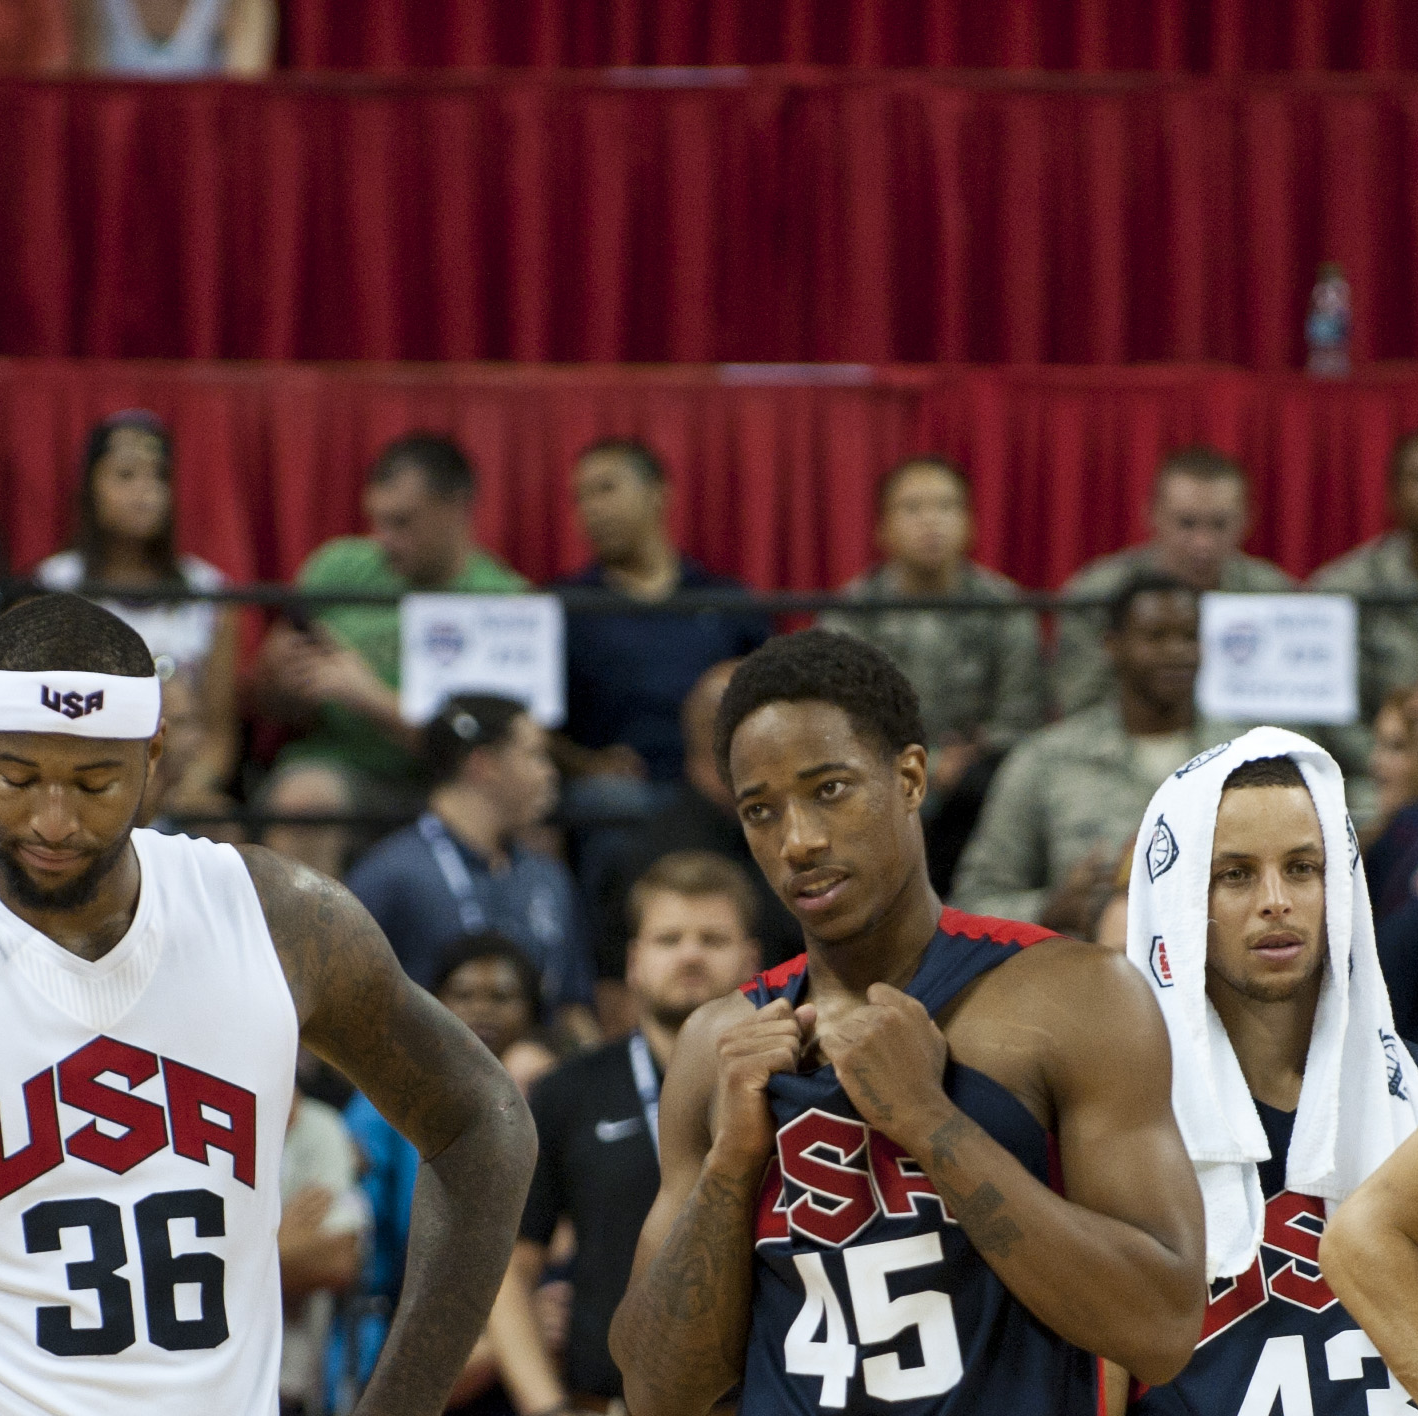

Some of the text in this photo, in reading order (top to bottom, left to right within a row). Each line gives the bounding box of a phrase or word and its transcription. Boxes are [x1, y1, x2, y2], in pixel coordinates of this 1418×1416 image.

[41, 684, 104, 720] USA
[21, 1188, 231, 1357] 36
[783, 1231, 965, 1409] 45
